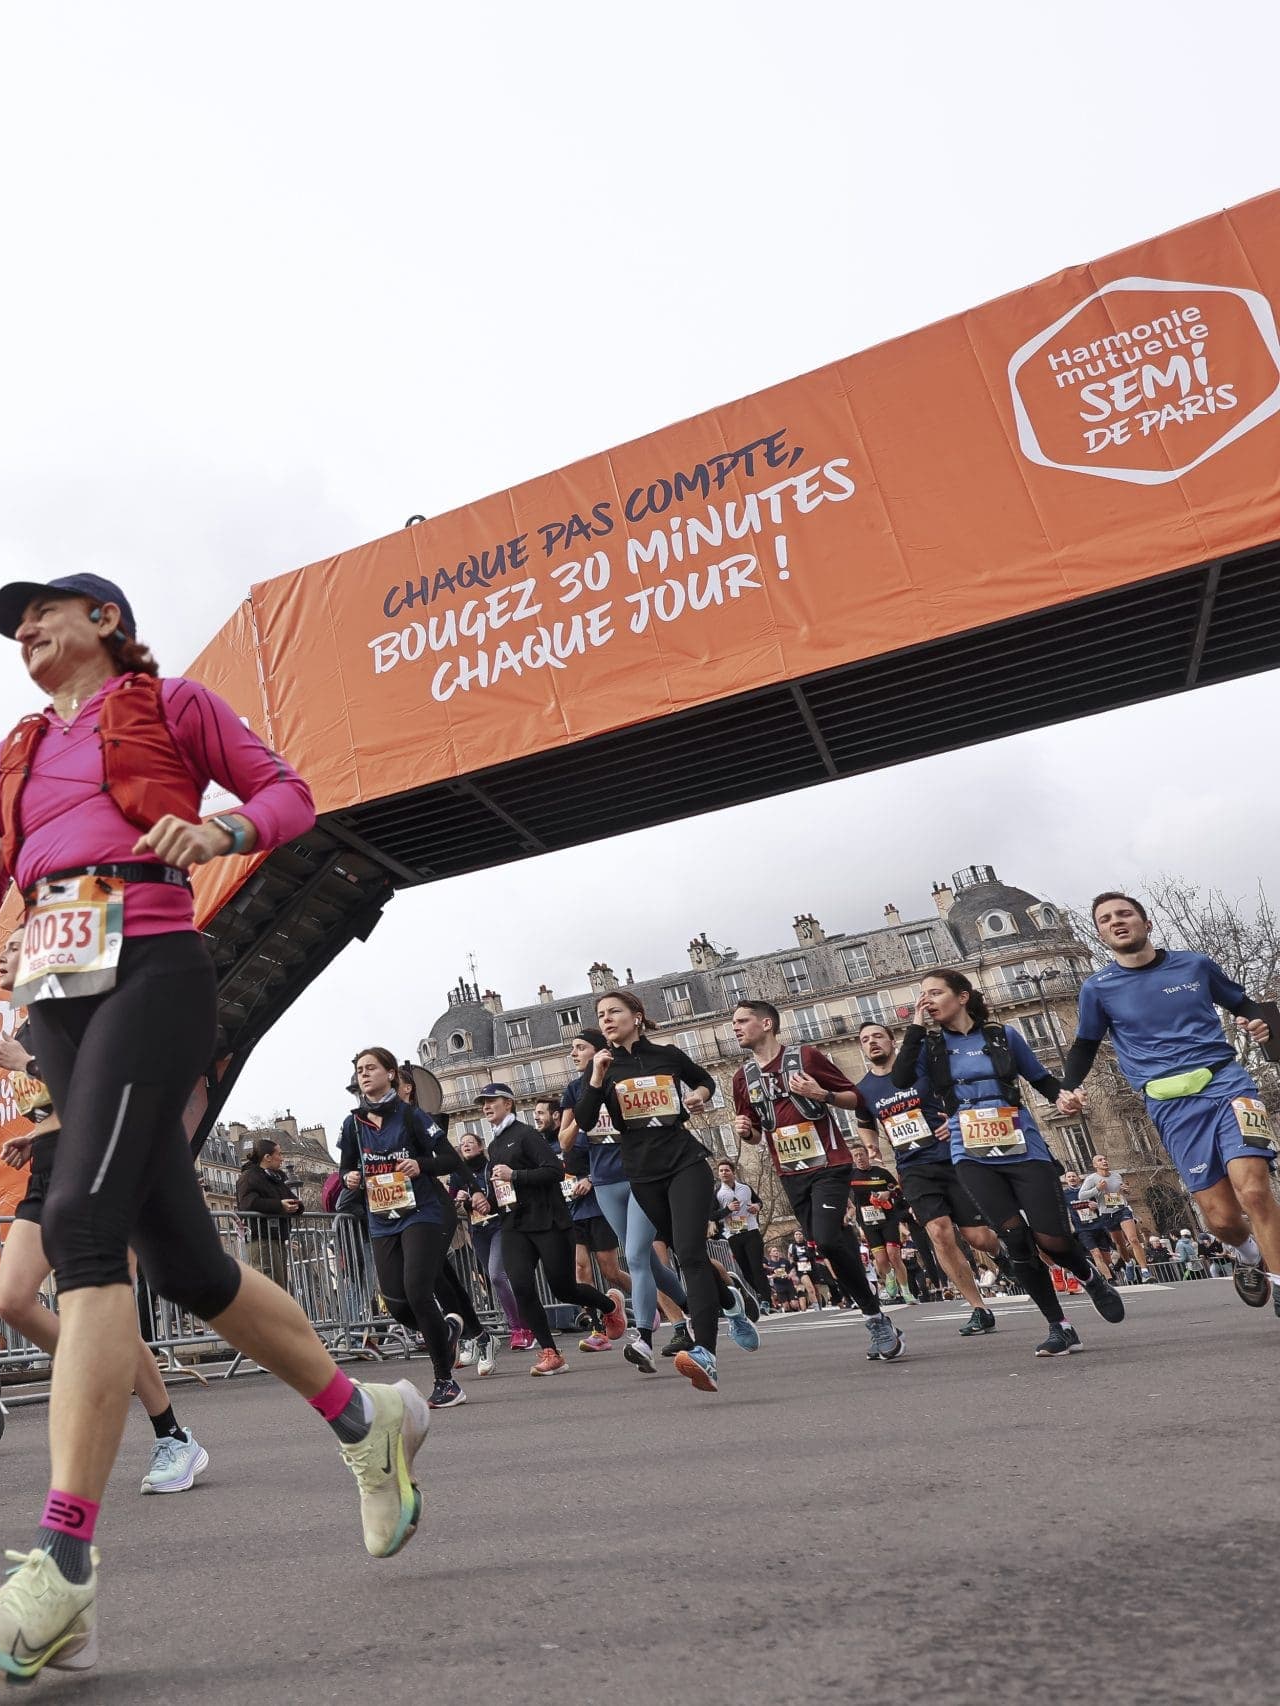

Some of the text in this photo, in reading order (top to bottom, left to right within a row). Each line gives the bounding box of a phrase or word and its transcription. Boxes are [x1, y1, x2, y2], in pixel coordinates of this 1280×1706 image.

[1047, 306, 1201, 371] Harmonie
[1056, 324, 1209, 388] mutuelle
[1083, 417, 1132, 454] DE
[382, 428, 805, 618] CHAQUE PAS COMPTE,
[367, 577, 542, 675] BOUGEZ
[550, 551, 612, 604] 30
[431, 600, 614, 701] CHAQUE
[24, 911, 92, 959] 40033
[623, 1089, 669, 1110] 54486
[892, 1121, 919, 1139] 44182
[966, 1121, 1009, 1139] 27389
[1243, 1112, 1267, 1130] 224
[777, 1136, 811, 1154] 44470
